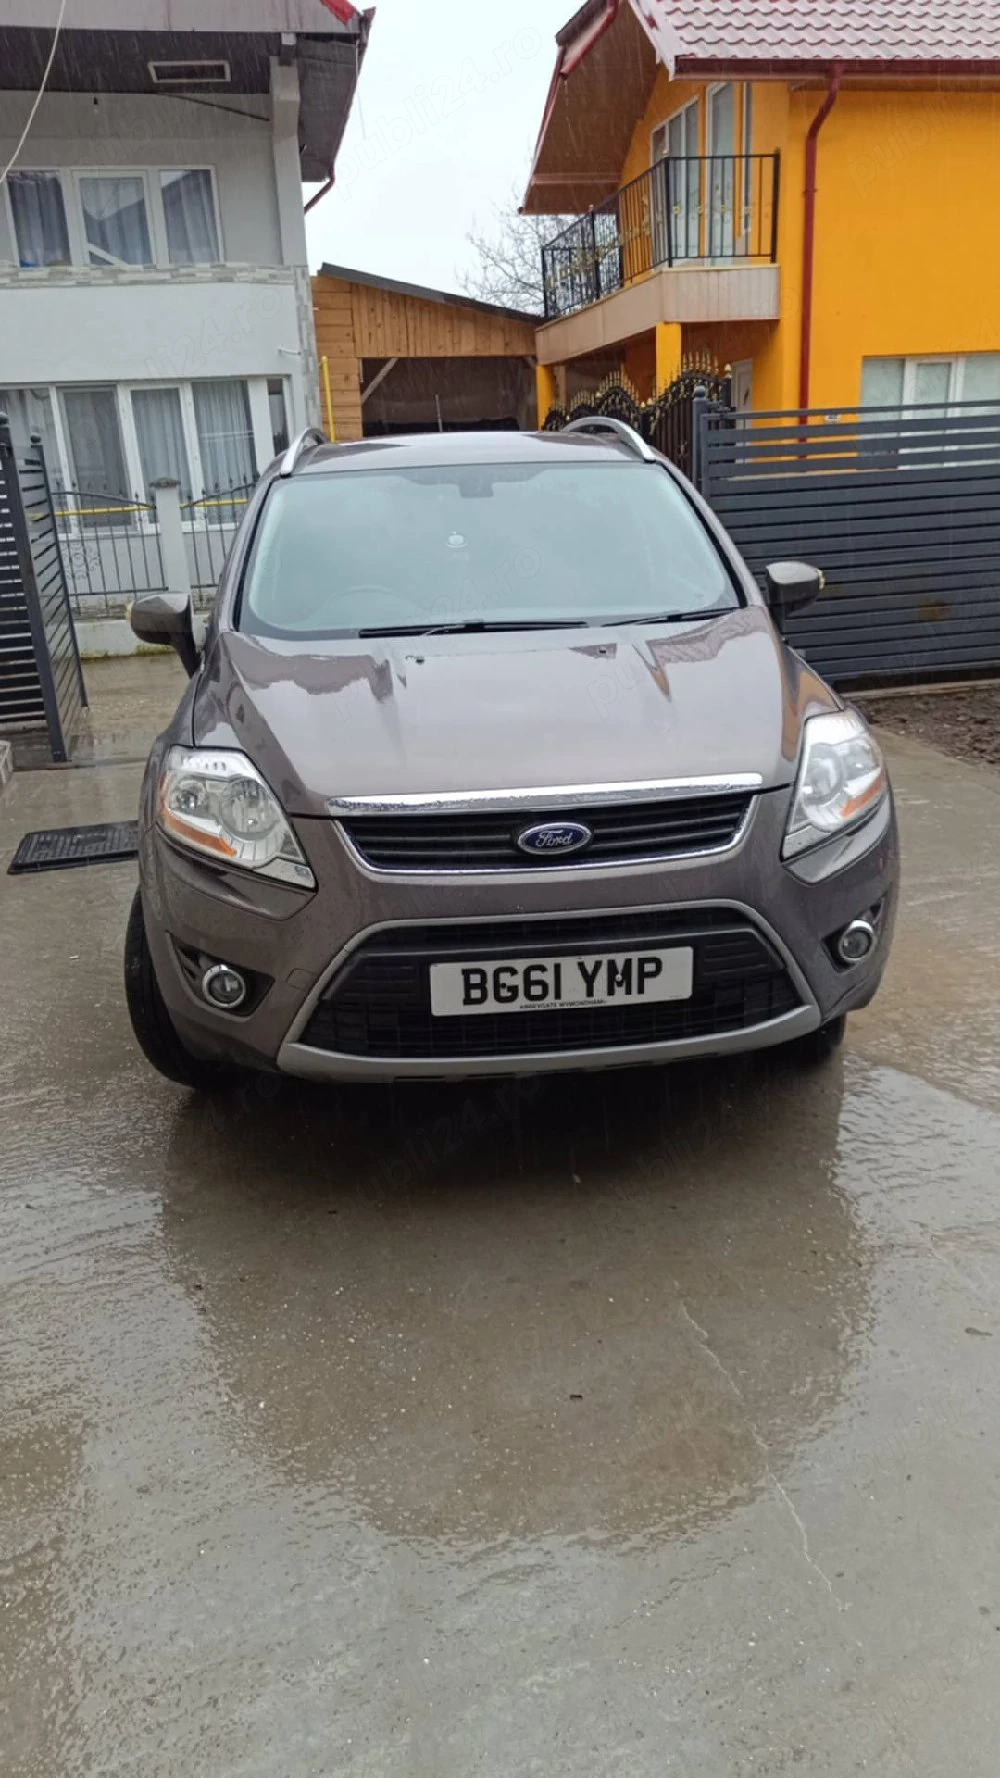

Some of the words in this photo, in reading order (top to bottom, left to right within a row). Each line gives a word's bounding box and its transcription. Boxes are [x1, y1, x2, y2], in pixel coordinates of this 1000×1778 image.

[535, 829, 574, 847] Ford
[461, 963, 561, 1005] BG61
[577, 956, 662, 998] YMP
